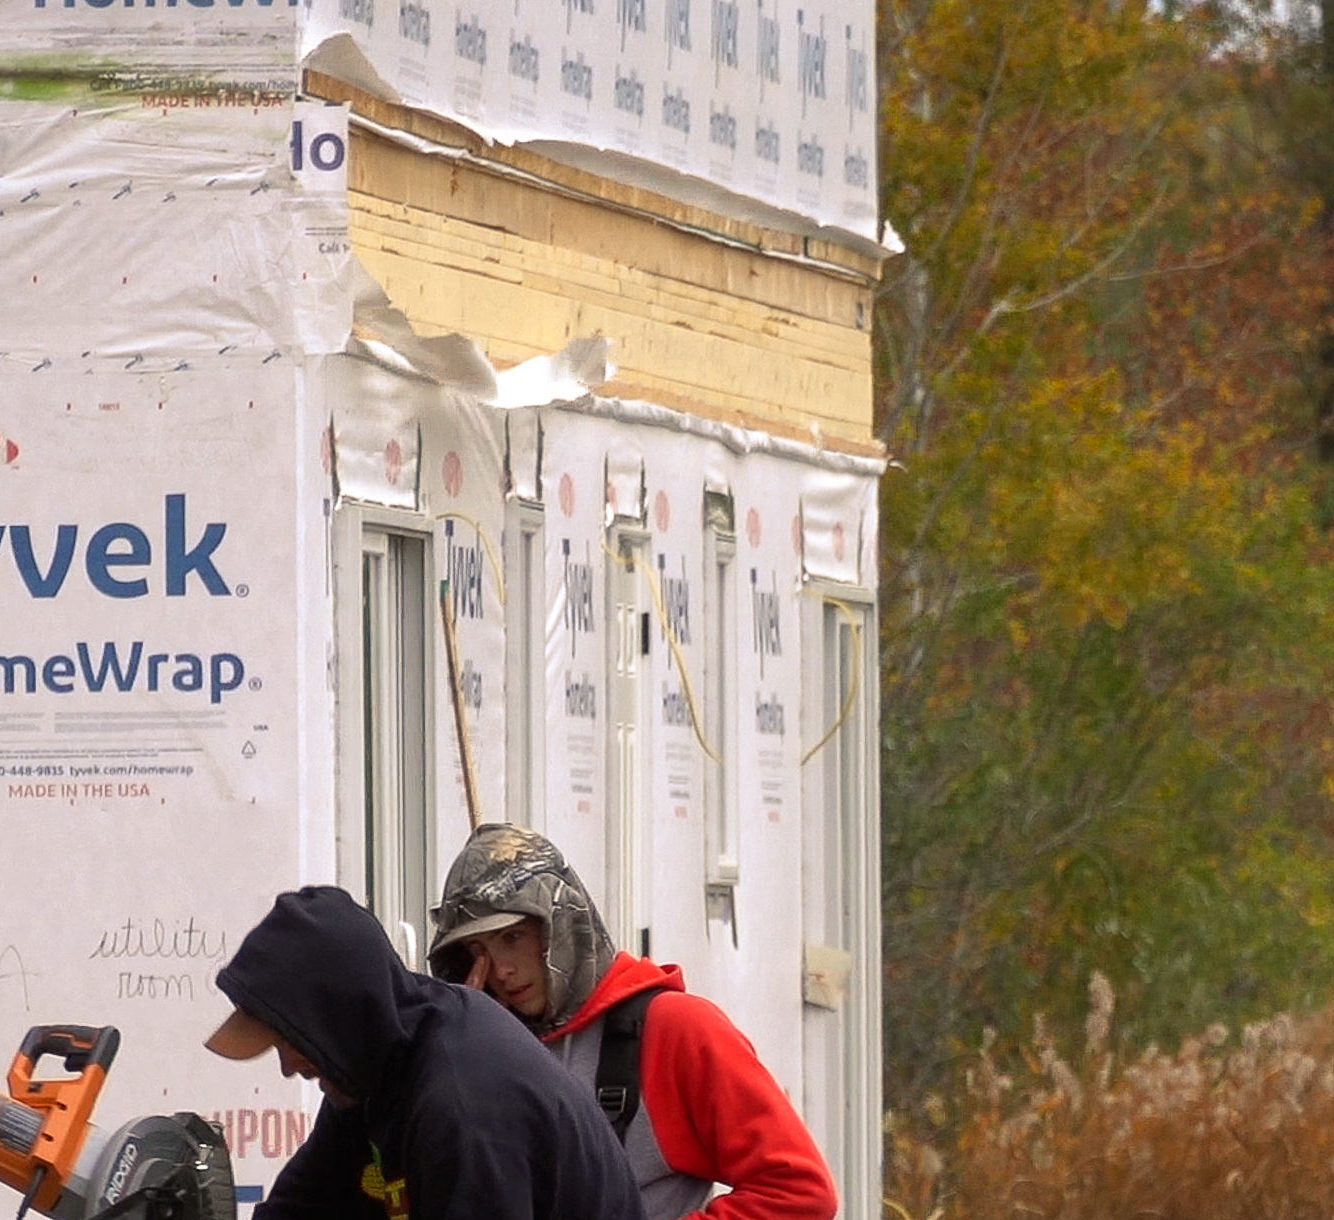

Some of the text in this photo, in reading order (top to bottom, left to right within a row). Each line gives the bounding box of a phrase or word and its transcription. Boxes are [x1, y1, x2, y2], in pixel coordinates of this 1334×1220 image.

[142, 91, 284, 108] MADE IN THE USA
[69, 764, 194, 778] tyvek.com/homewrap
[8, 783, 151, 798] MADE IN THE USA
[89, 916, 227, 972] utility
[117, 972, 194, 1000] room
[202, 1109, 312, 1159] UPON
[105, 1143, 138, 1206] RIDGID
